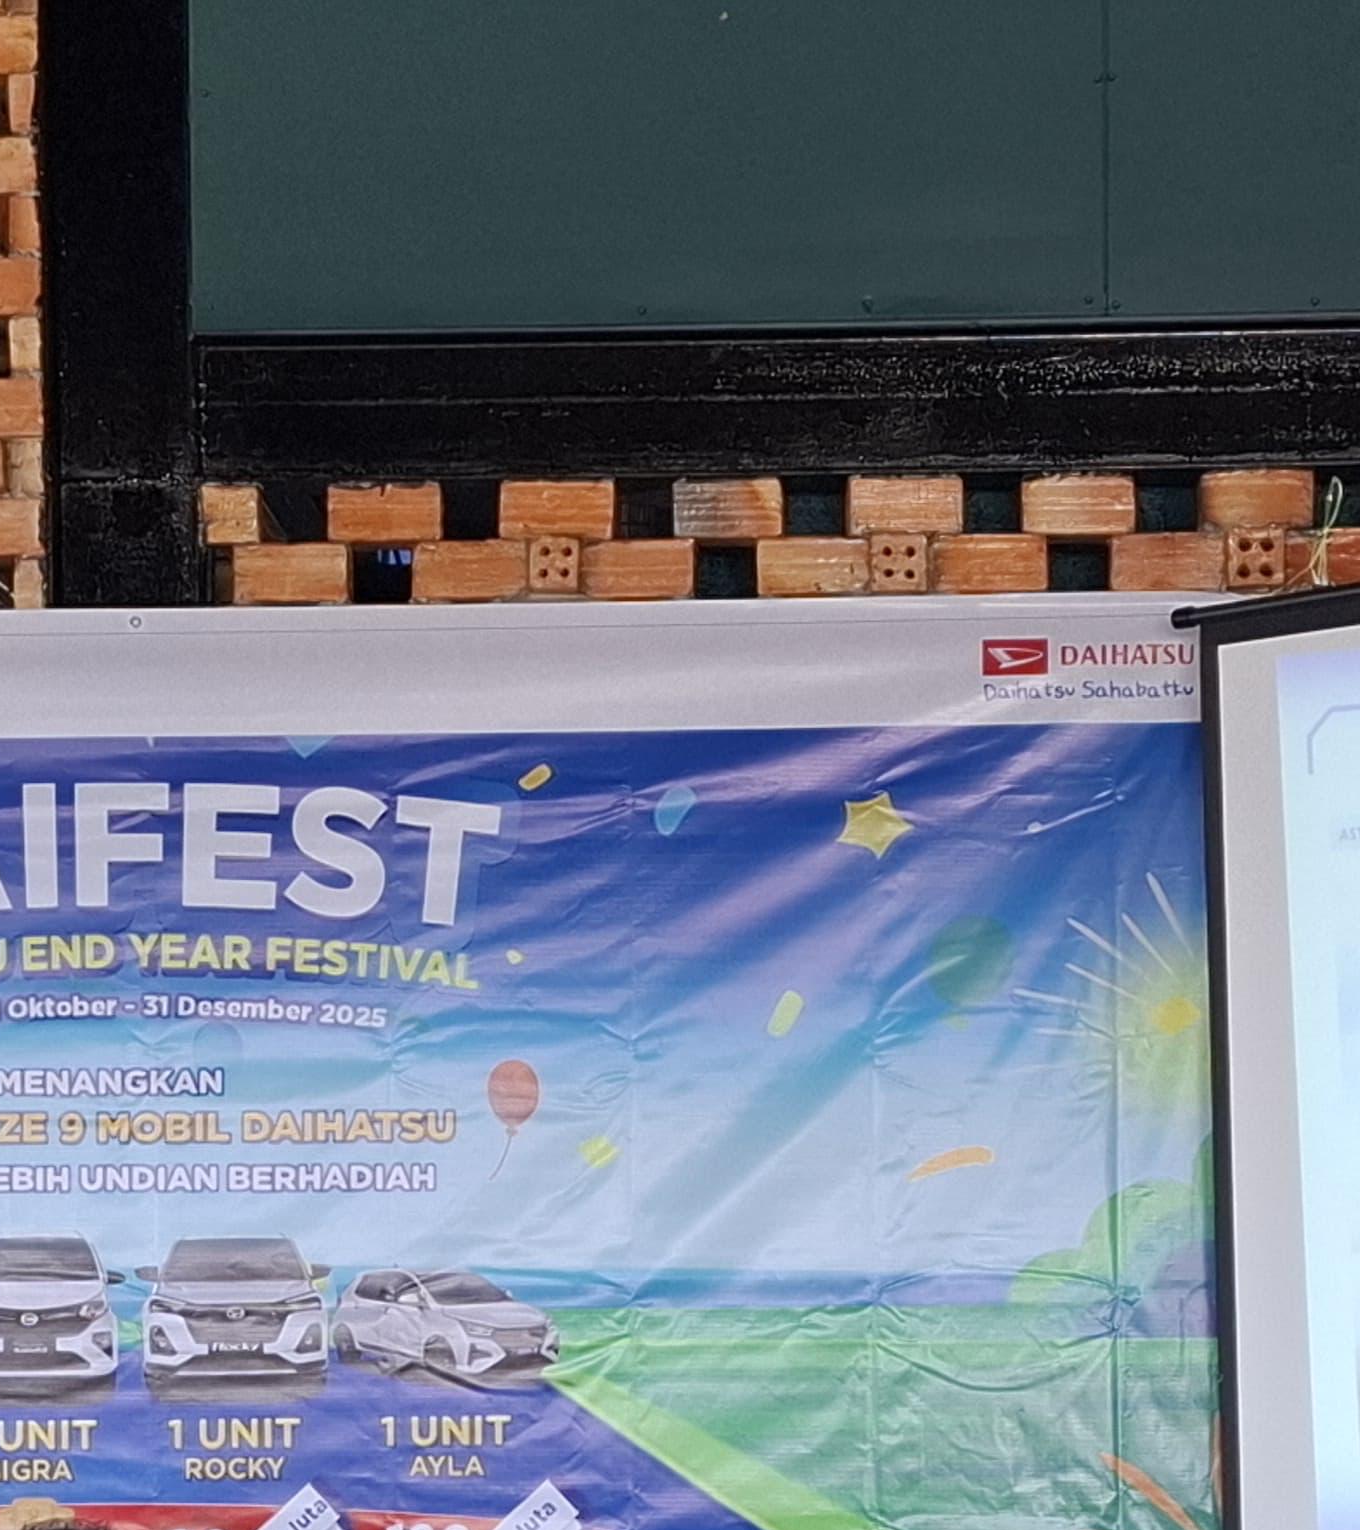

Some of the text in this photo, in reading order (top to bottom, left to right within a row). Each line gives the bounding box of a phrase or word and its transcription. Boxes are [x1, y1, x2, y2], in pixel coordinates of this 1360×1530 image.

[1060, 643, 1195, 665] DAIHATSU
[984, 680, 1076, 701] Daihatsu
[22, 934, 115, 972] END
[128, 933, 251, 970] YEAR
[266, 936, 480, 989] FESTIVAL
[7, 995, 117, 1020] Oktober
[142, 995, 169, 1018] 31
[177, 996, 313, 1022] Desember
[320, 1003, 388, 1028] 2025
[58, 1111, 88, 1145] 9
[96, 1110, 232, 1145] MOBIL
[241, 1109, 456, 1144] DAIHATSU
[78, 1164, 220, 1193] UNDIAN
[227, 1162, 438, 1193] BERHADIAH
[167, 1417, 302, 1450] 1 UNIT
[380, 1414, 512, 1447] 1 UNIT
[184, 1456, 285, 1480] ROCKY
[409, 1455, 485, 1477] AYLA
